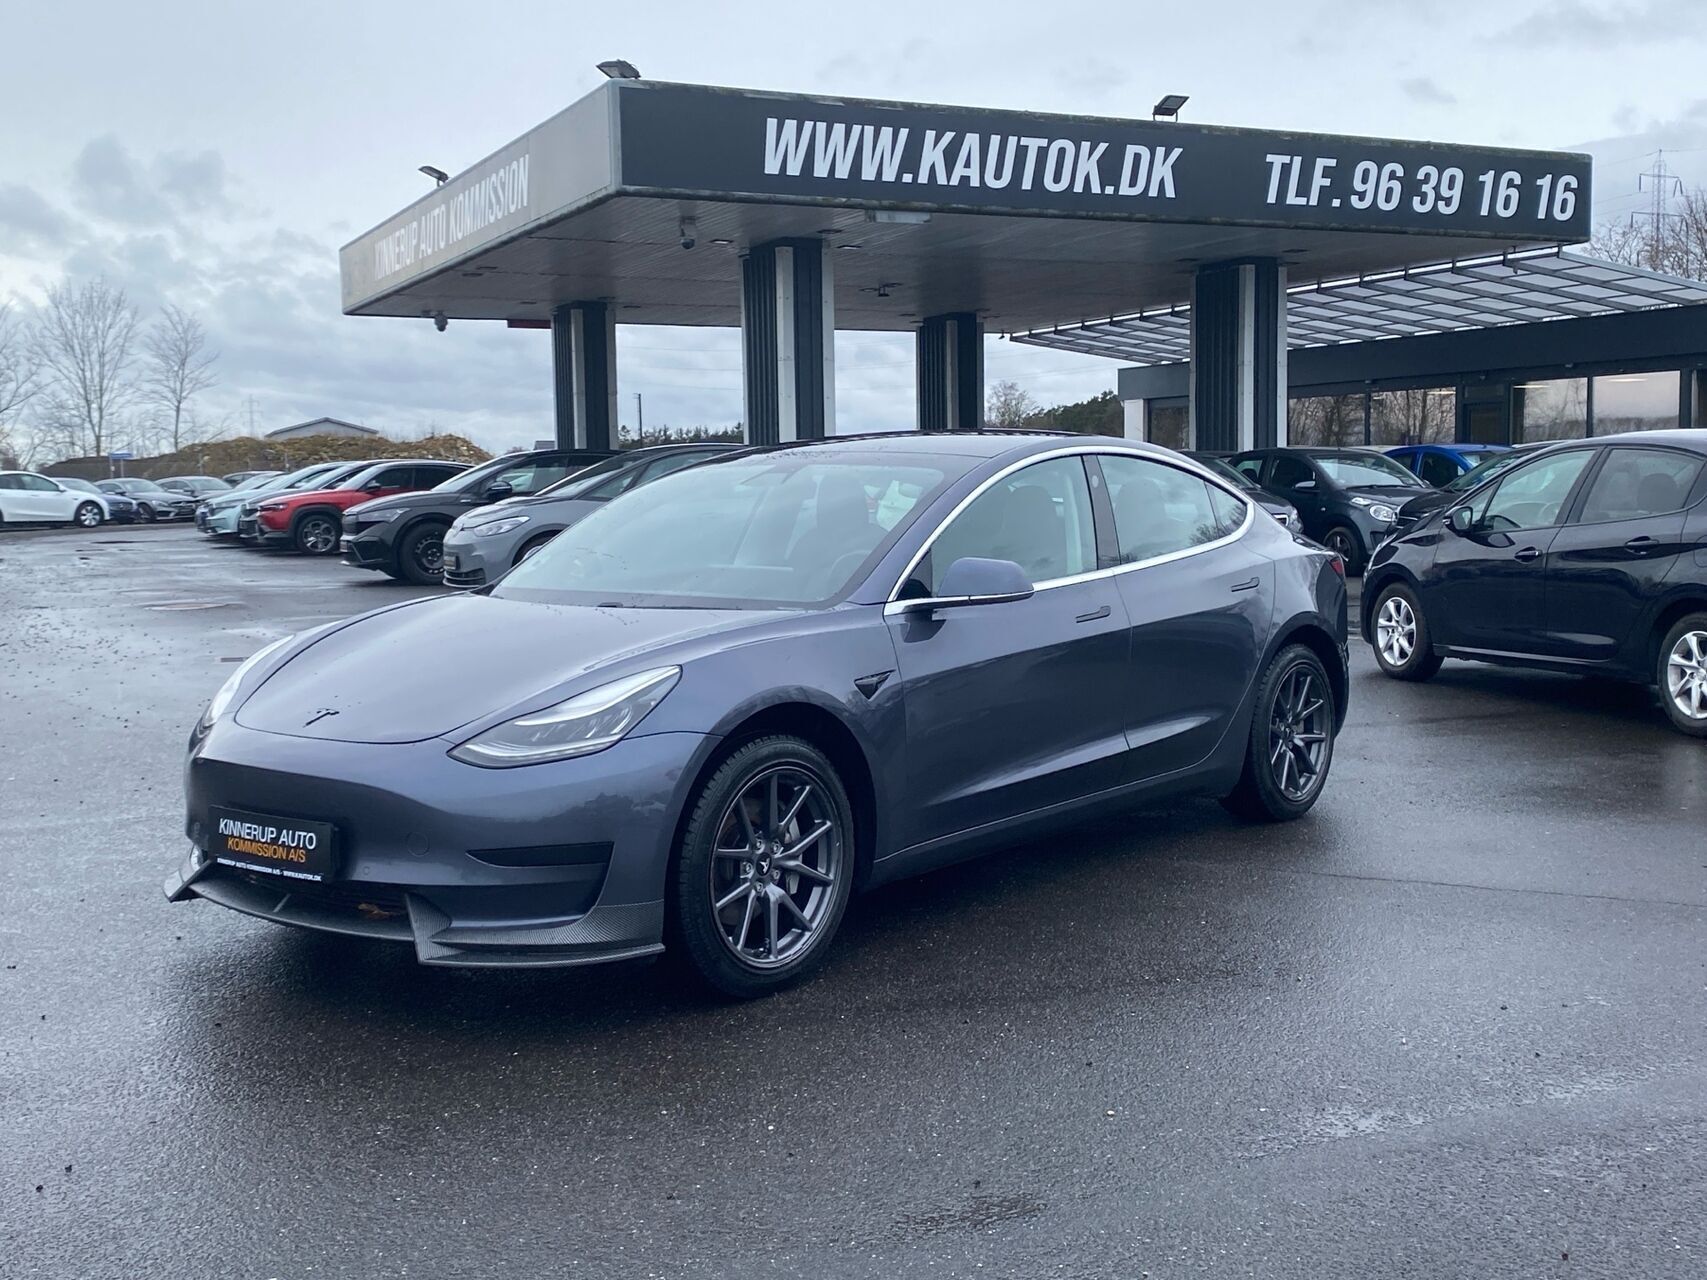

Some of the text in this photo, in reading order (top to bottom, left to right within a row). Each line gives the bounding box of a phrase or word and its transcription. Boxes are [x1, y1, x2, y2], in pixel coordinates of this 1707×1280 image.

[764, 117, 1184, 198] WWW.KAUTOK.DK
[1265, 153, 1578, 222] TLF. 96 39 16 16
[374, 153, 529, 281] KINNERUP AUTO KOMMISSION
[218, 818, 317, 850] KINNERUP AUTO
[227, 837, 306, 863] KOMMISSION A/S
